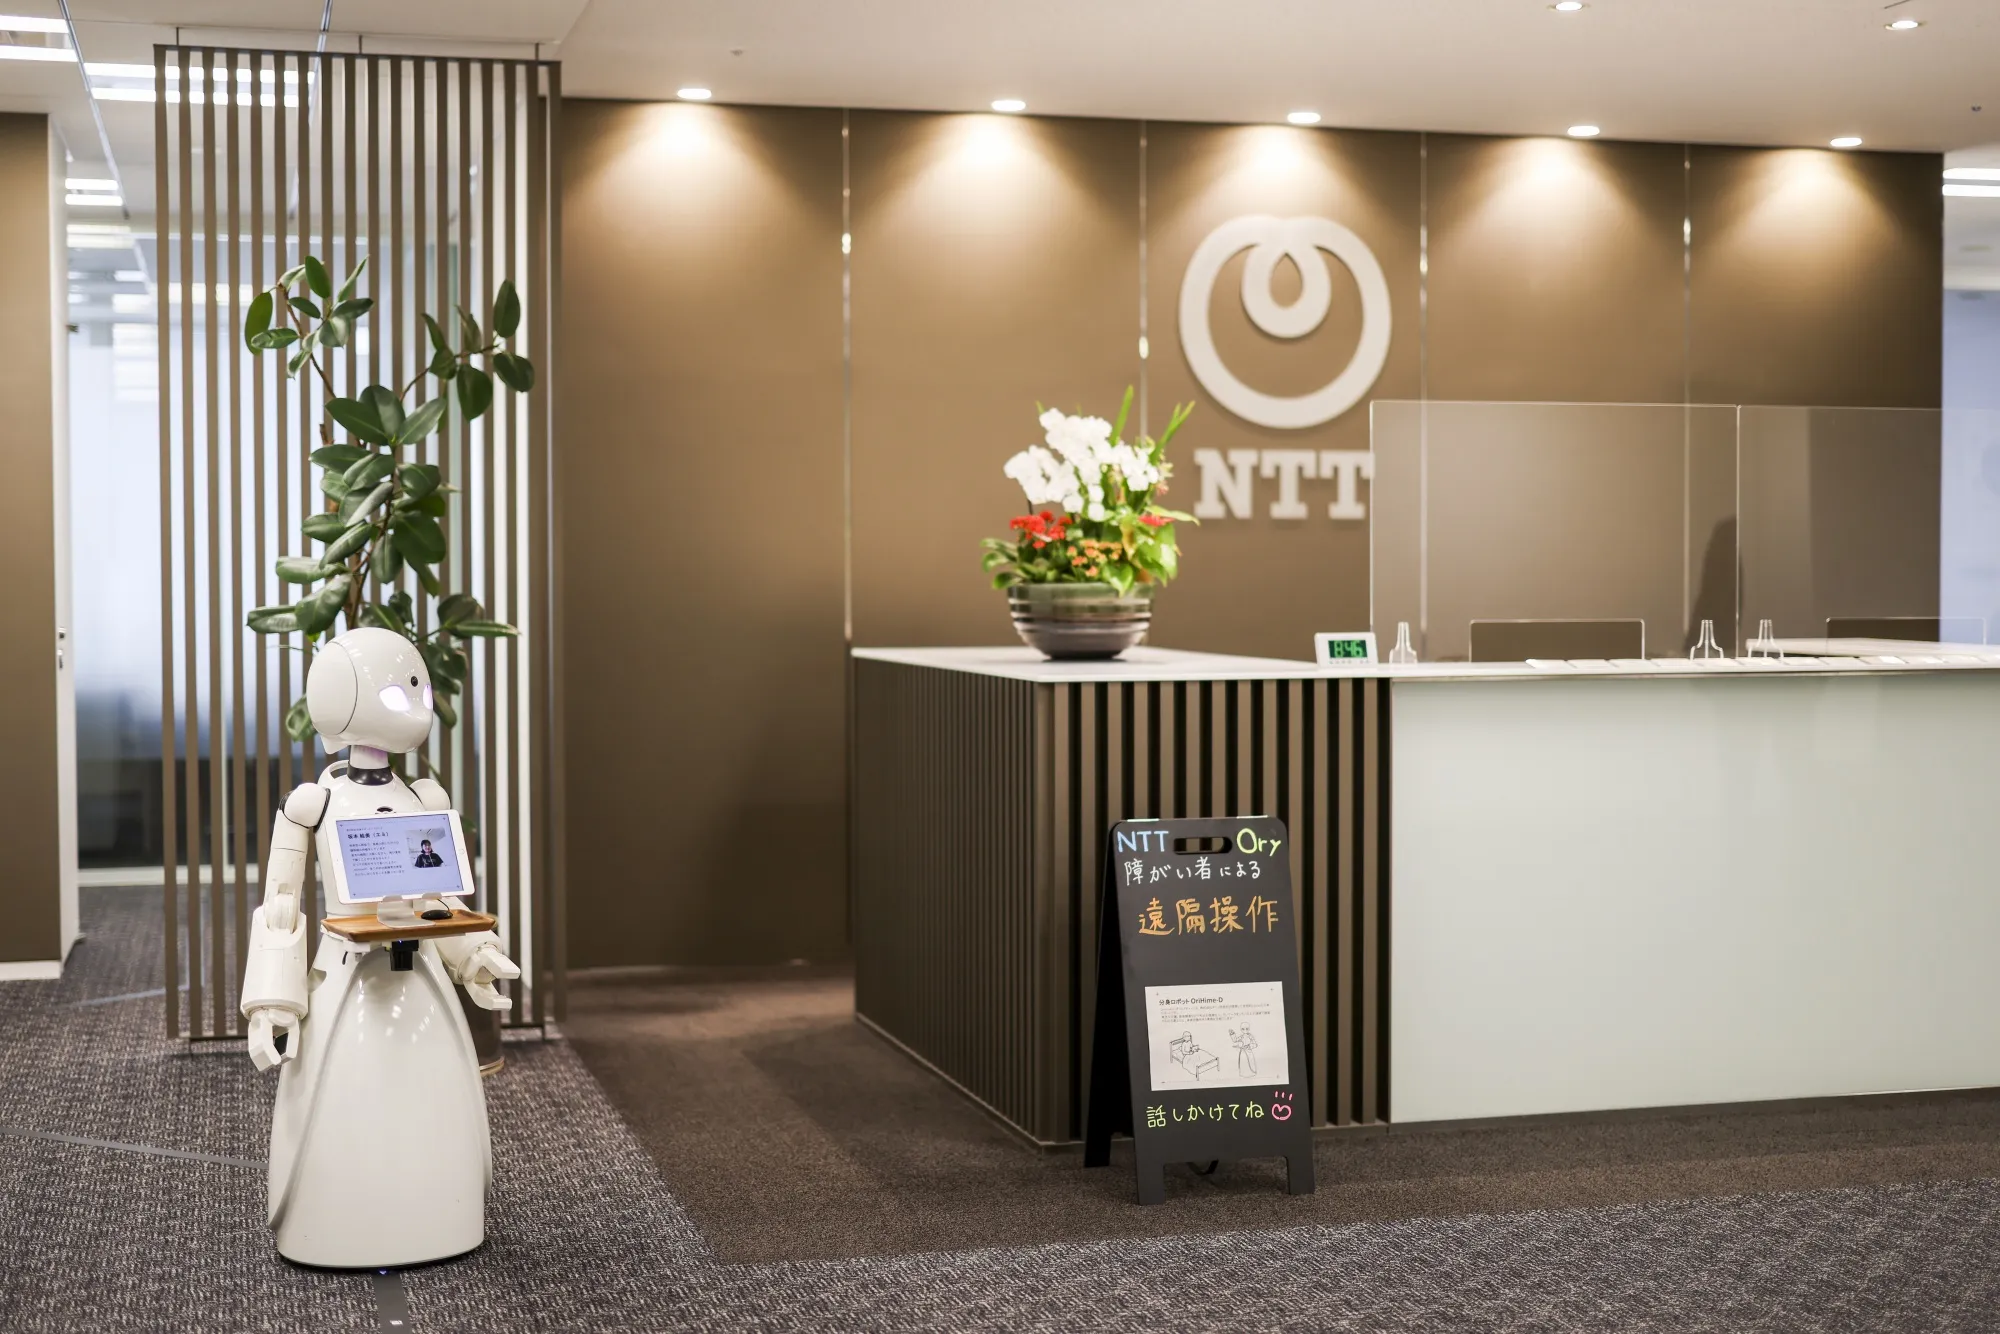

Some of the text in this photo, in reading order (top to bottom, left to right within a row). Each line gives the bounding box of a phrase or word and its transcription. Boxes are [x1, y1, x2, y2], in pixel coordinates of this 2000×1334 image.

[1194, 448, 1375, 520] NTT
[1117, 827, 1282, 857] NTT Ory
[1124, 856, 1261, 886] 障がい者による
[1138, 895, 1279, 936] 遠隔操作
[1159, 998, 1190, 1006] 分身ロボット
[1146, 1101, 1264, 1128] 話しかけてね
